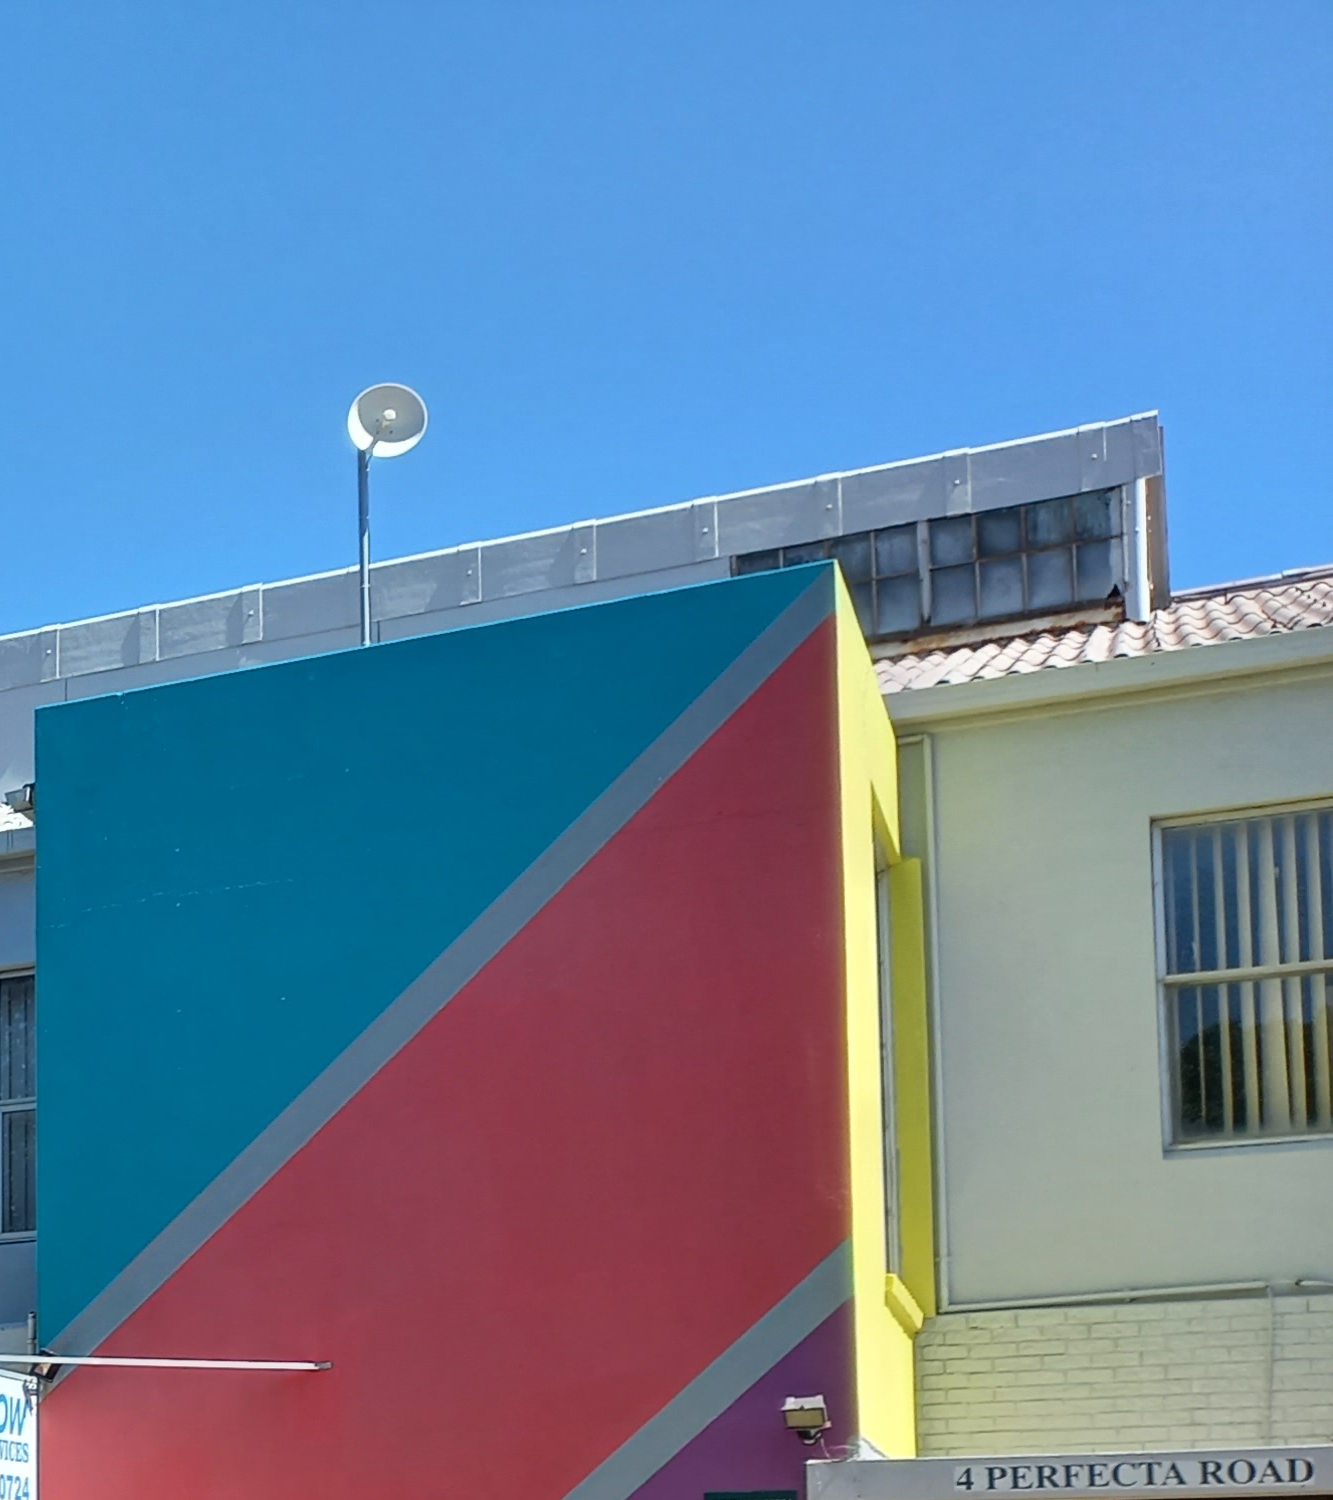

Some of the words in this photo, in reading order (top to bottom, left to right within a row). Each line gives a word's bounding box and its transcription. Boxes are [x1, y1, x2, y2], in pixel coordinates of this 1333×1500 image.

[956, 1466, 974, 1490] 4
[985, 1462, 1186, 1490] PERFECTA
[1198, 1458, 1314, 1485] ROAD
